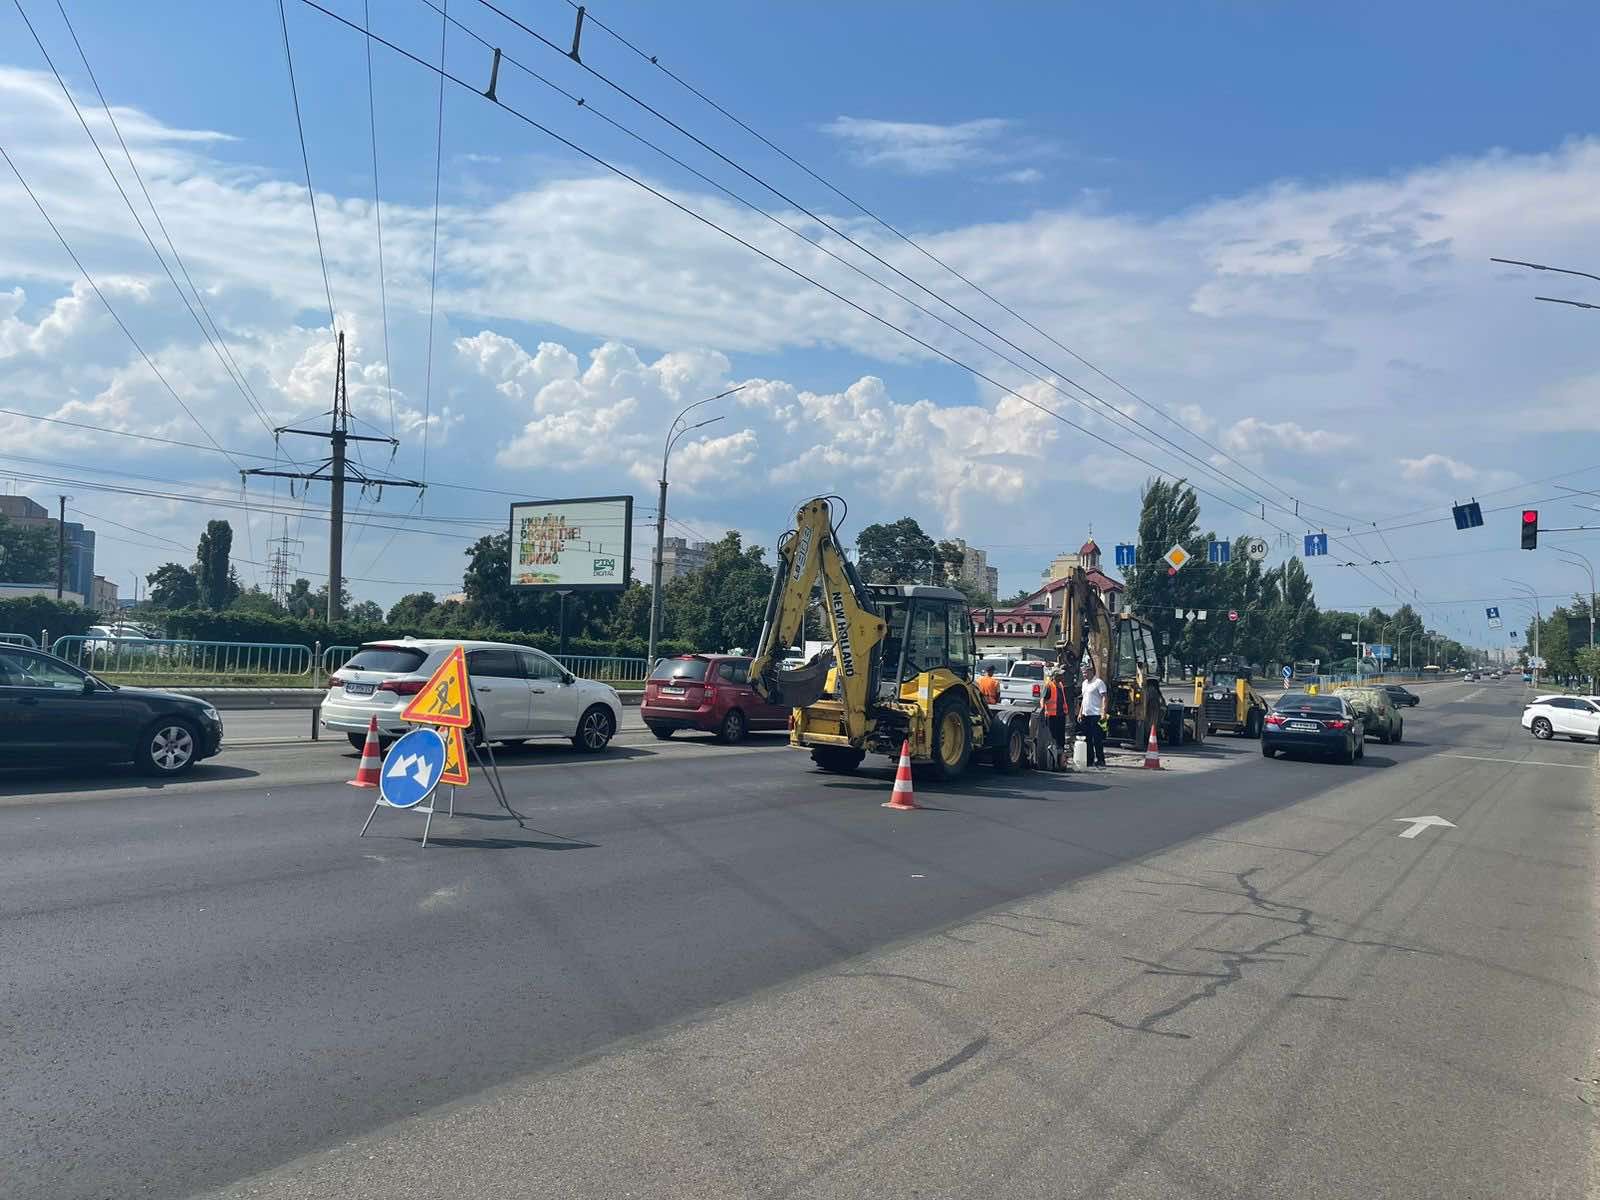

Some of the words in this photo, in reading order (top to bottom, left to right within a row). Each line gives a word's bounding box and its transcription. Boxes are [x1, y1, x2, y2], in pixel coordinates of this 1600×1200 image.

[1251, 544, 1264, 553] 80
[832, 591, 845, 619] NEW
[837, 620, 855, 677] HOLLAND
